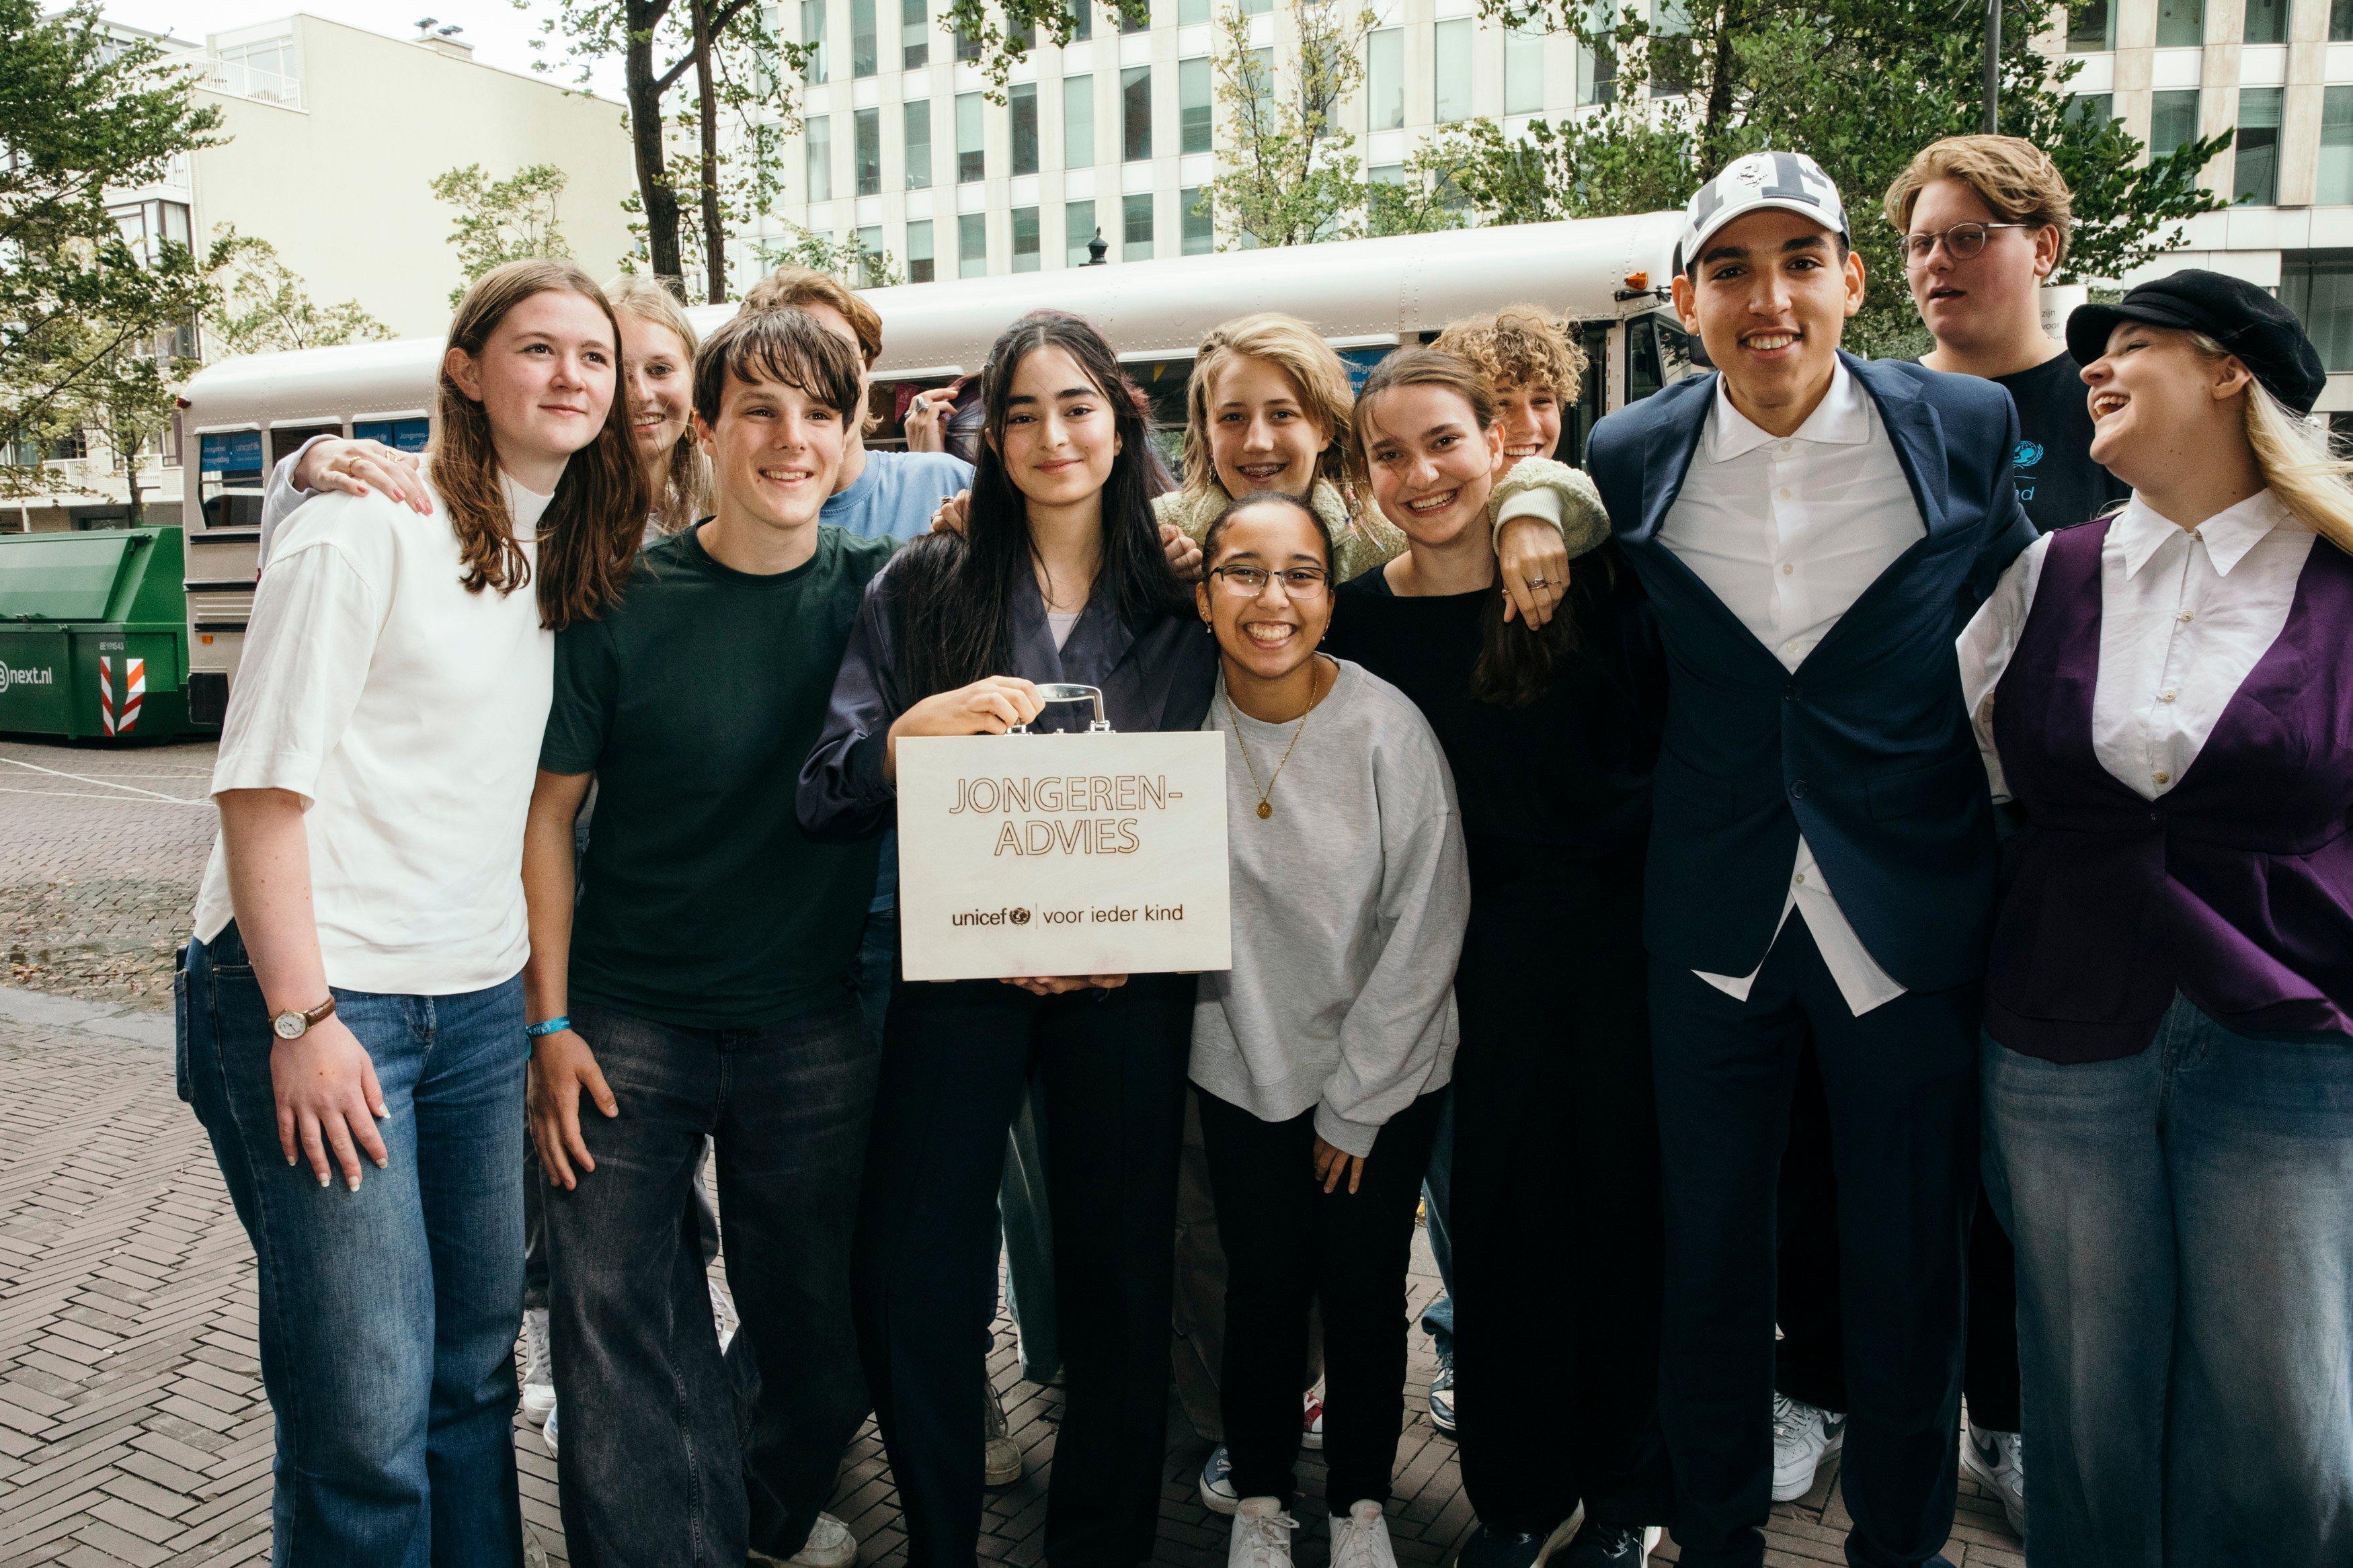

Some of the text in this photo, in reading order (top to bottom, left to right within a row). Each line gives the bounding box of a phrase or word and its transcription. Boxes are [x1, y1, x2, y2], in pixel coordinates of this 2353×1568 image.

[2042, 310, 2056, 319] zijn
[949, 775, 1183, 814] JONGEREN-
[994, 818, 1140, 856] ADVIES
[952, 904, 1184, 926] unicef voor ieder kind
